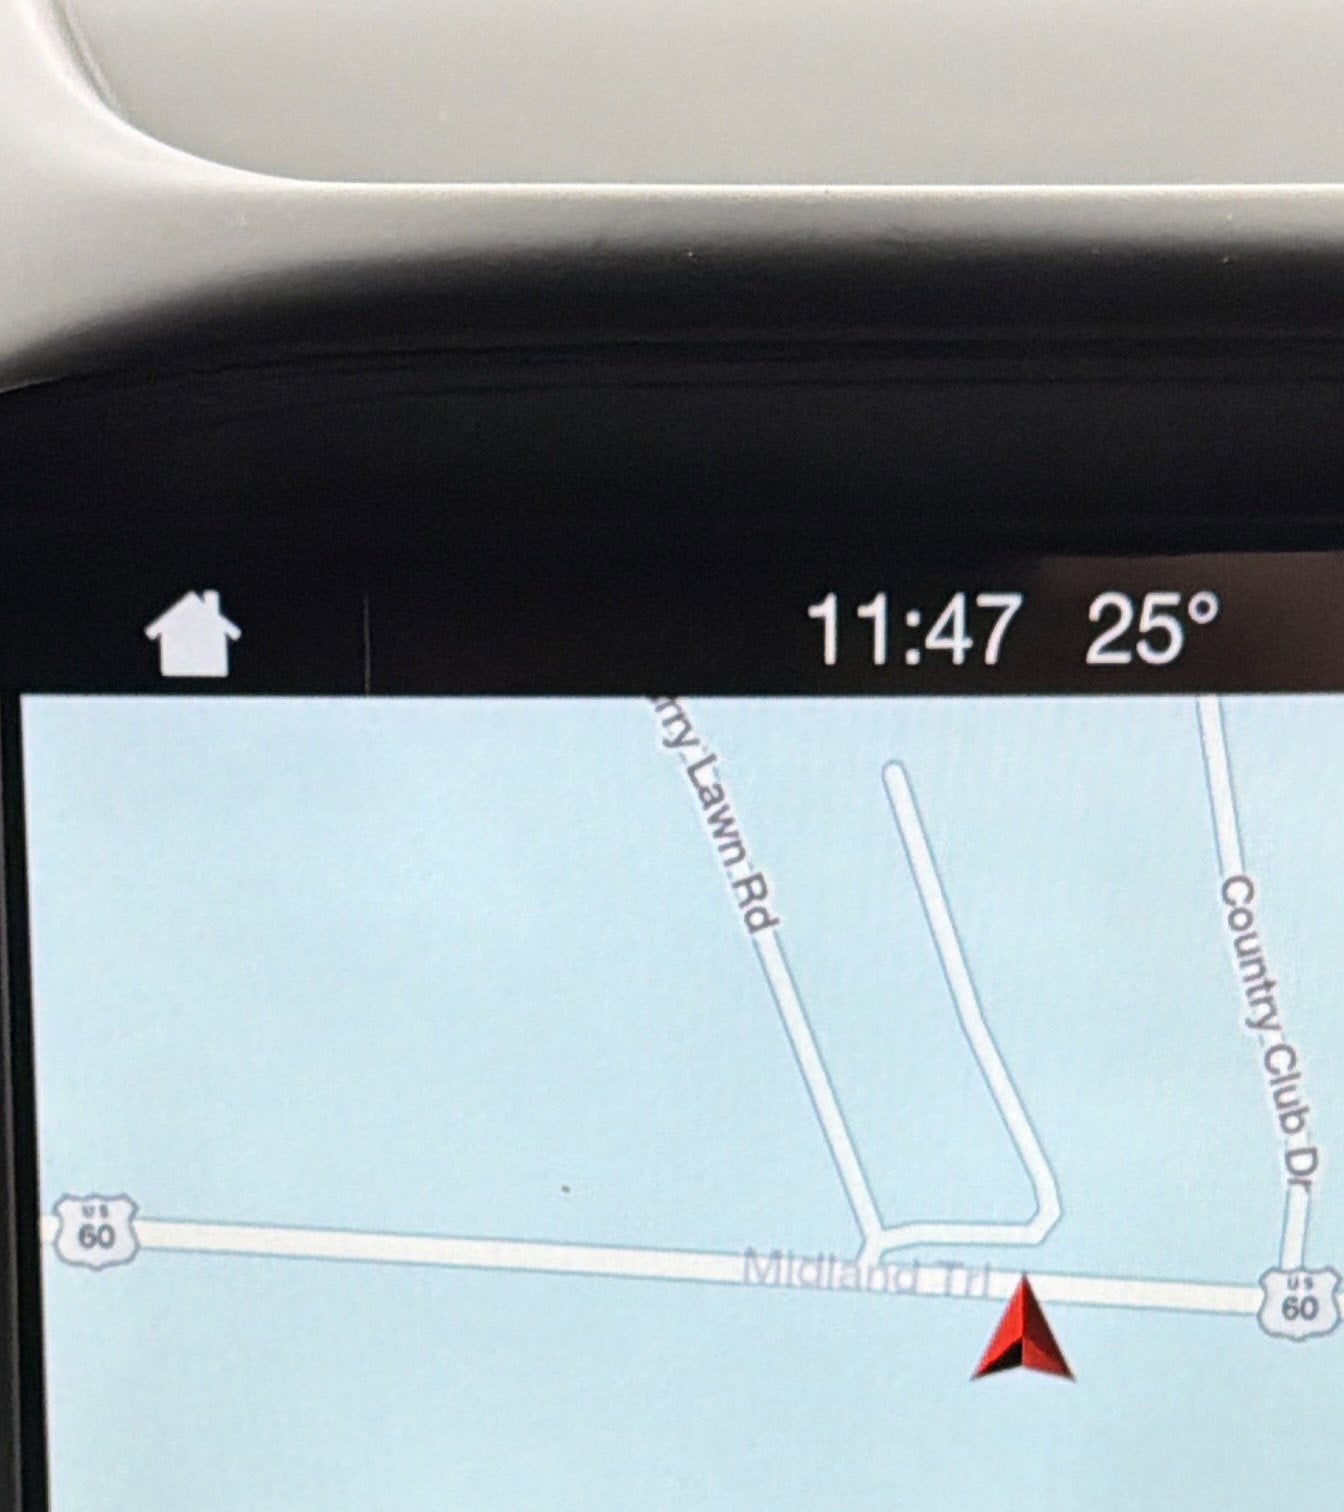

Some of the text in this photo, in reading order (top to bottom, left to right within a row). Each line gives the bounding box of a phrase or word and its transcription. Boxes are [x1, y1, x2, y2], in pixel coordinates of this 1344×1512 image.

[808, 590, 1220, 666] 11:47 25°
[649, 696, 780, 935] rry Lawn Rd
[1221, 874, 1319, 1192] Country Club Dr
[78, 1223, 116, 1250] 60
[742, 1247, 990, 1299] Midland Trl
[1281, 1295, 1319, 1321] 60
